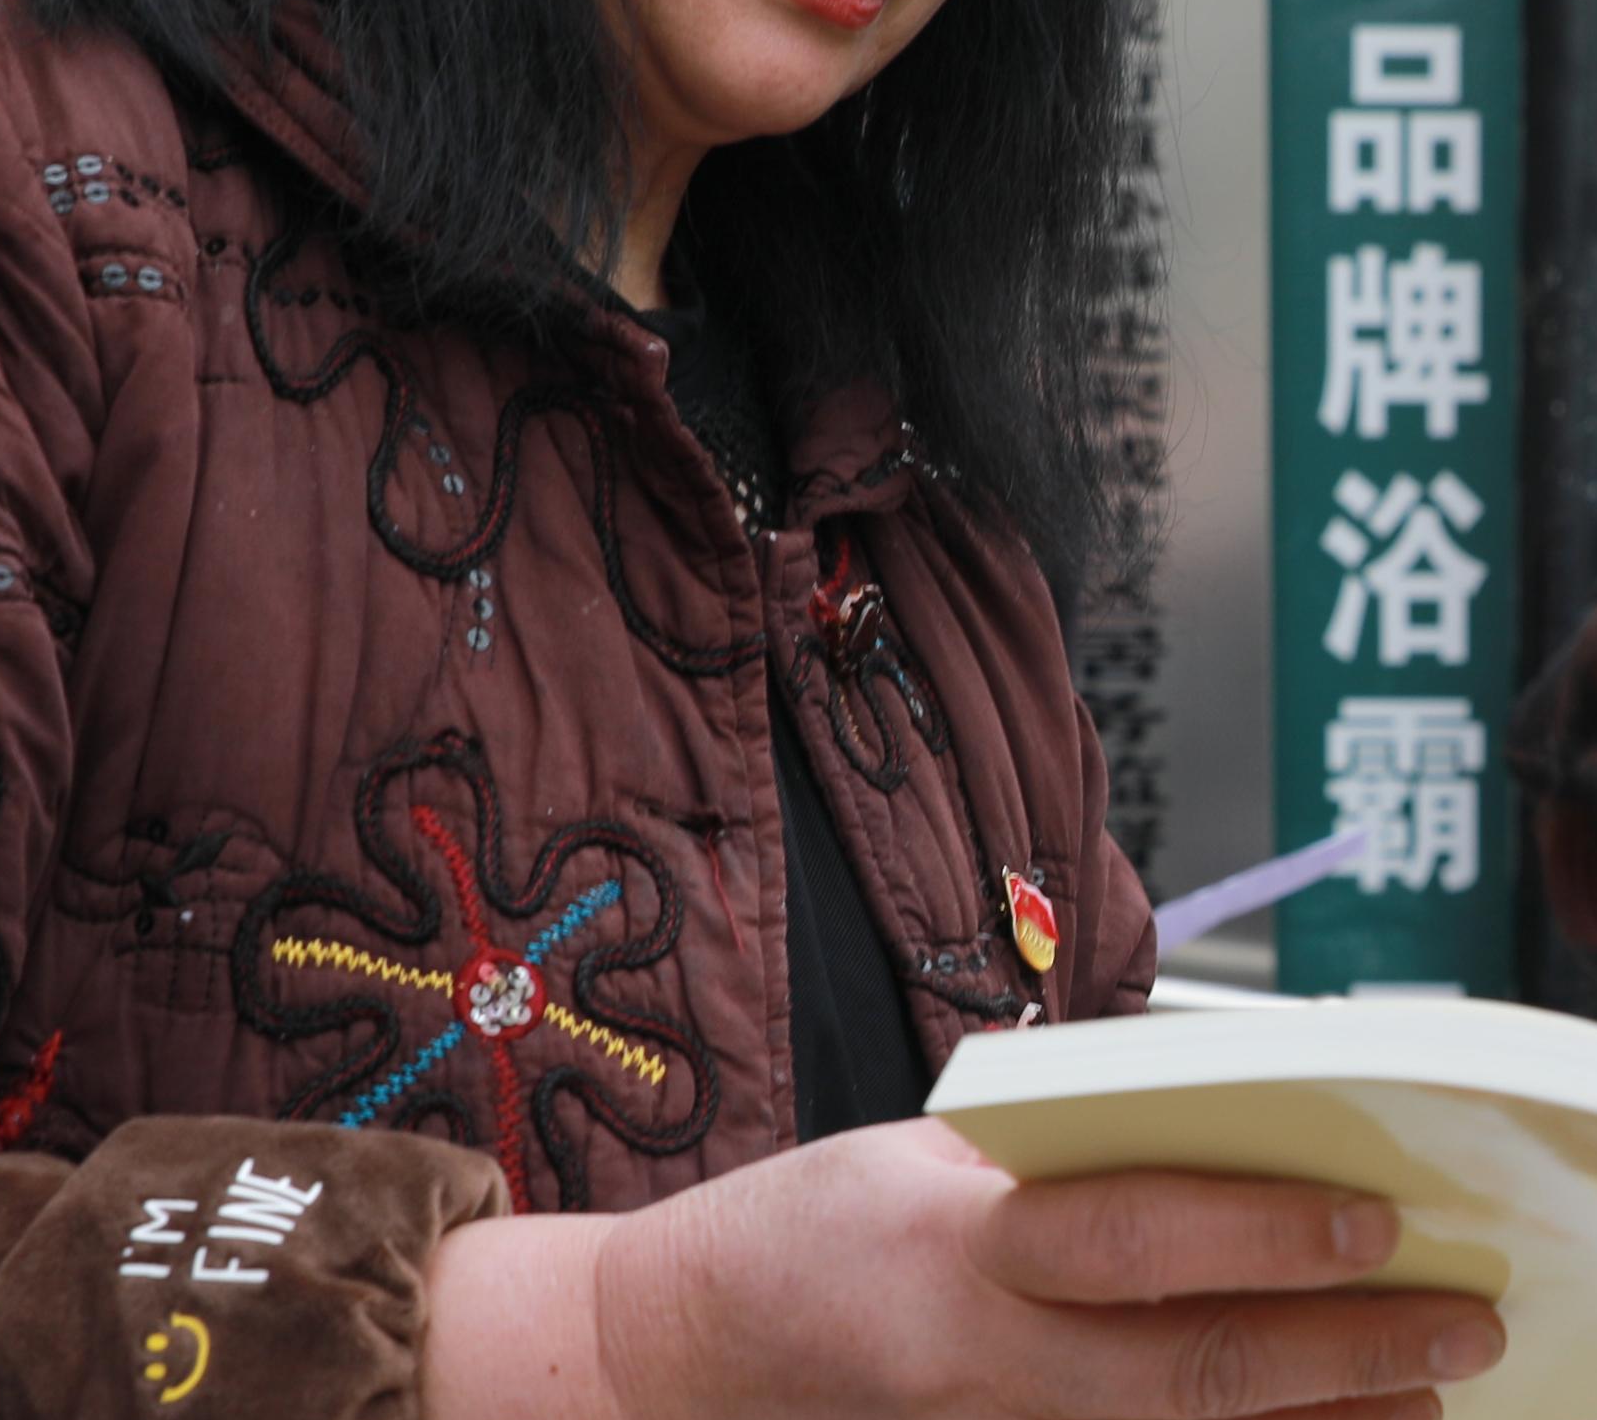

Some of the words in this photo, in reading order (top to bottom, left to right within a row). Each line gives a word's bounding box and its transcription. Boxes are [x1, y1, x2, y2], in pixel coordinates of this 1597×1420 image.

[1315, 23, 1489, 995] 品牌浴霸
[117, 1198, 199, 1280] I'M
[190, 1157, 324, 1285] FINE
